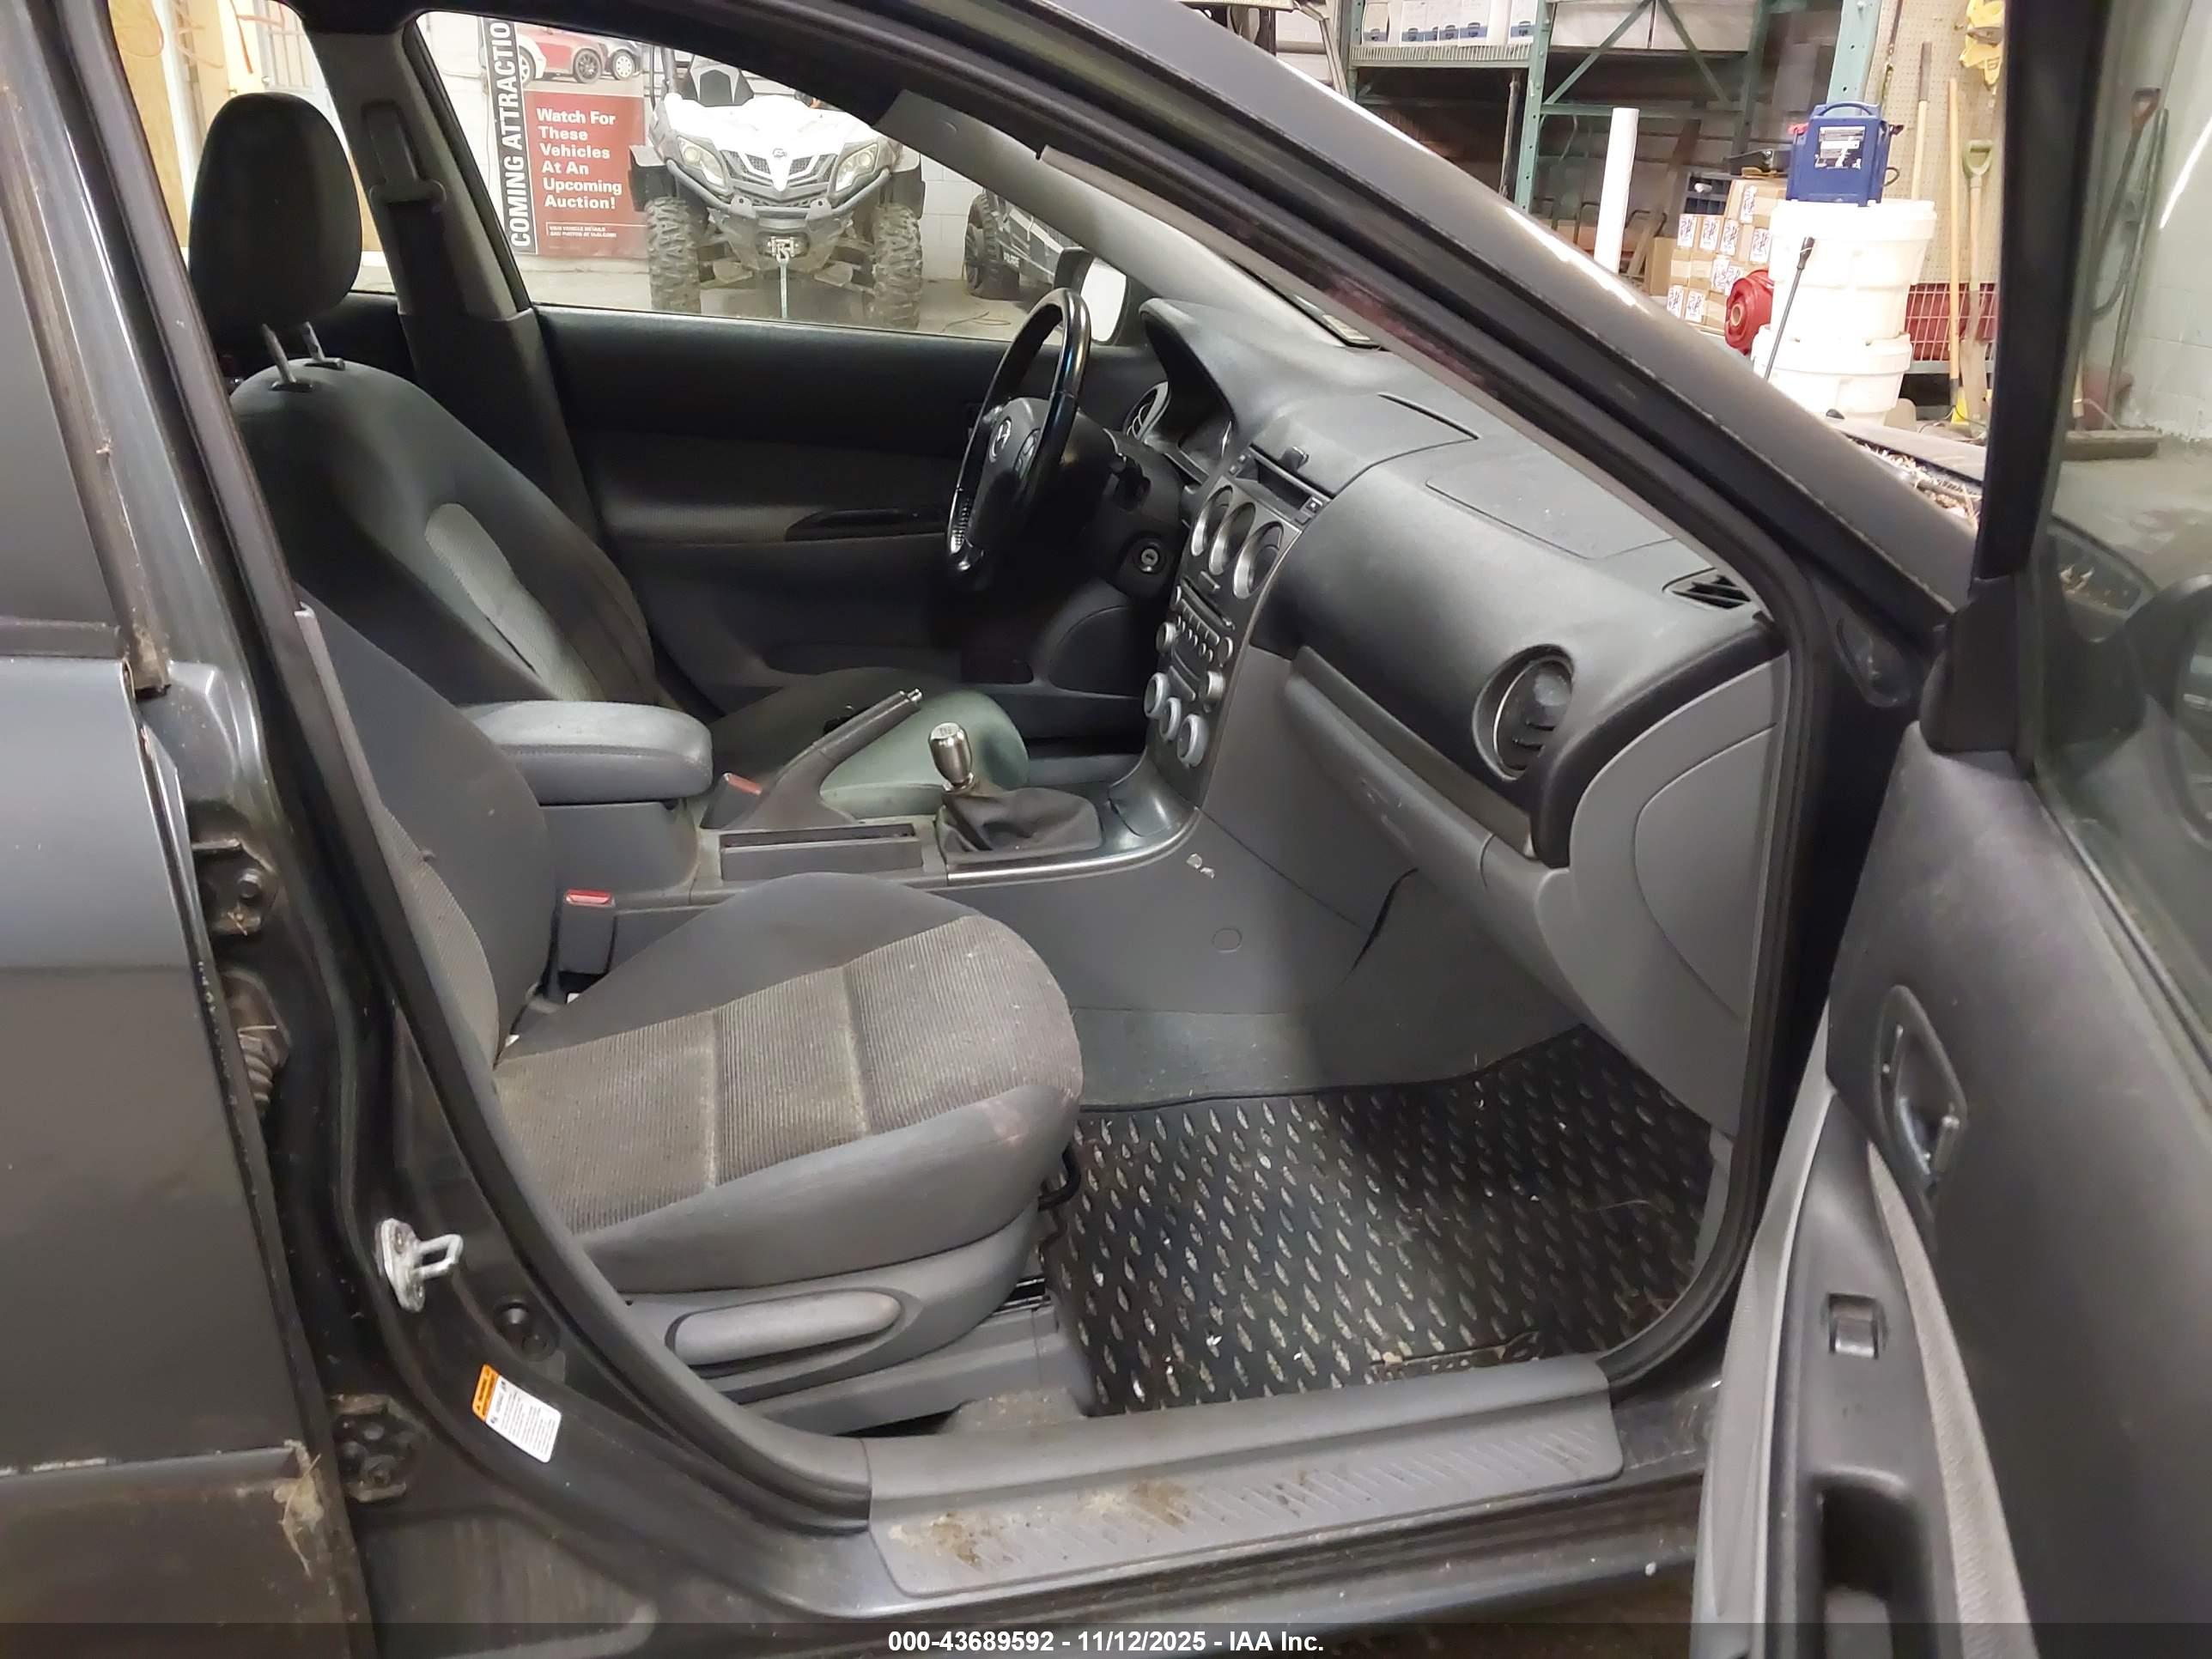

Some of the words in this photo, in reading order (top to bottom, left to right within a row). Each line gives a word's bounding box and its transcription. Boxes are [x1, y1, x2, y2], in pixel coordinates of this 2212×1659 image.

[489, 21, 523, 150] ATTRACTIO
[536, 108, 586, 125] Watch
[590, 110, 616, 125] For
[538, 126, 588, 141] These
[539, 143, 611, 159] Vehicles
[541, 161, 561, 174] At
[566, 161, 589, 175] An
[543, 177, 623, 194] Upcoming
[503, 156, 531, 246] COMING
[544, 194, 616, 210] Auction!
